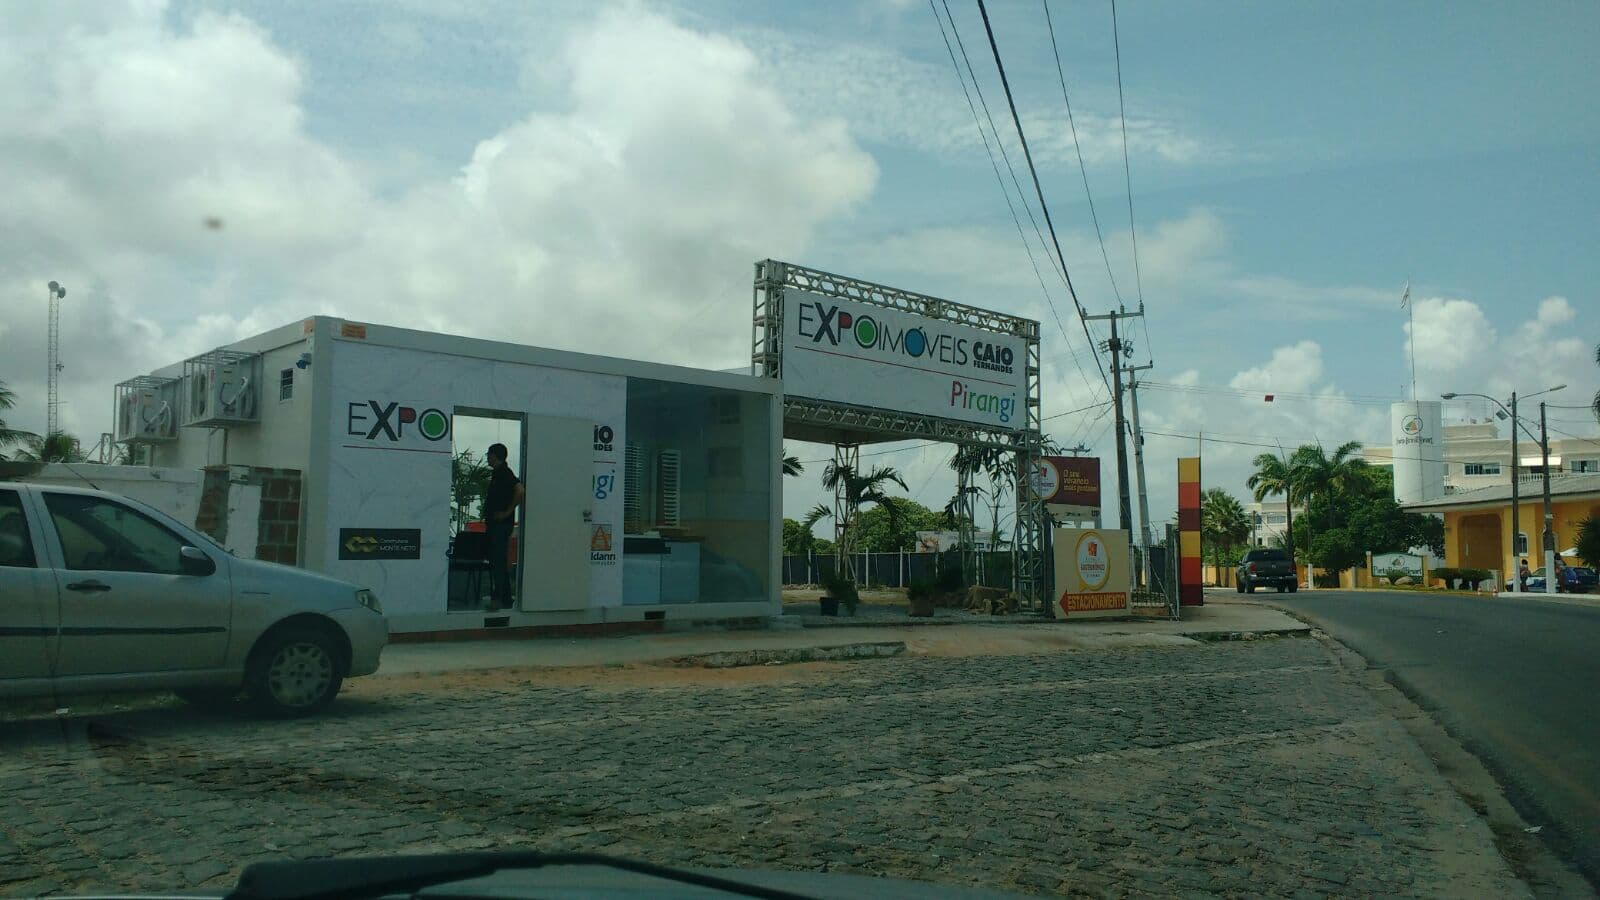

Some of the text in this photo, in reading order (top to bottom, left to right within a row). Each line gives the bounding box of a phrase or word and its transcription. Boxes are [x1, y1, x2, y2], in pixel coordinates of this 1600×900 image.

[799, 301, 968, 366] EXPOIMÓVEIS
[973, 359, 1013, 375] FERNANDES
[951, 380, 1016, 423] Pirangi
[1067, 593, 1126, 611] ESTACIONAMENTO
